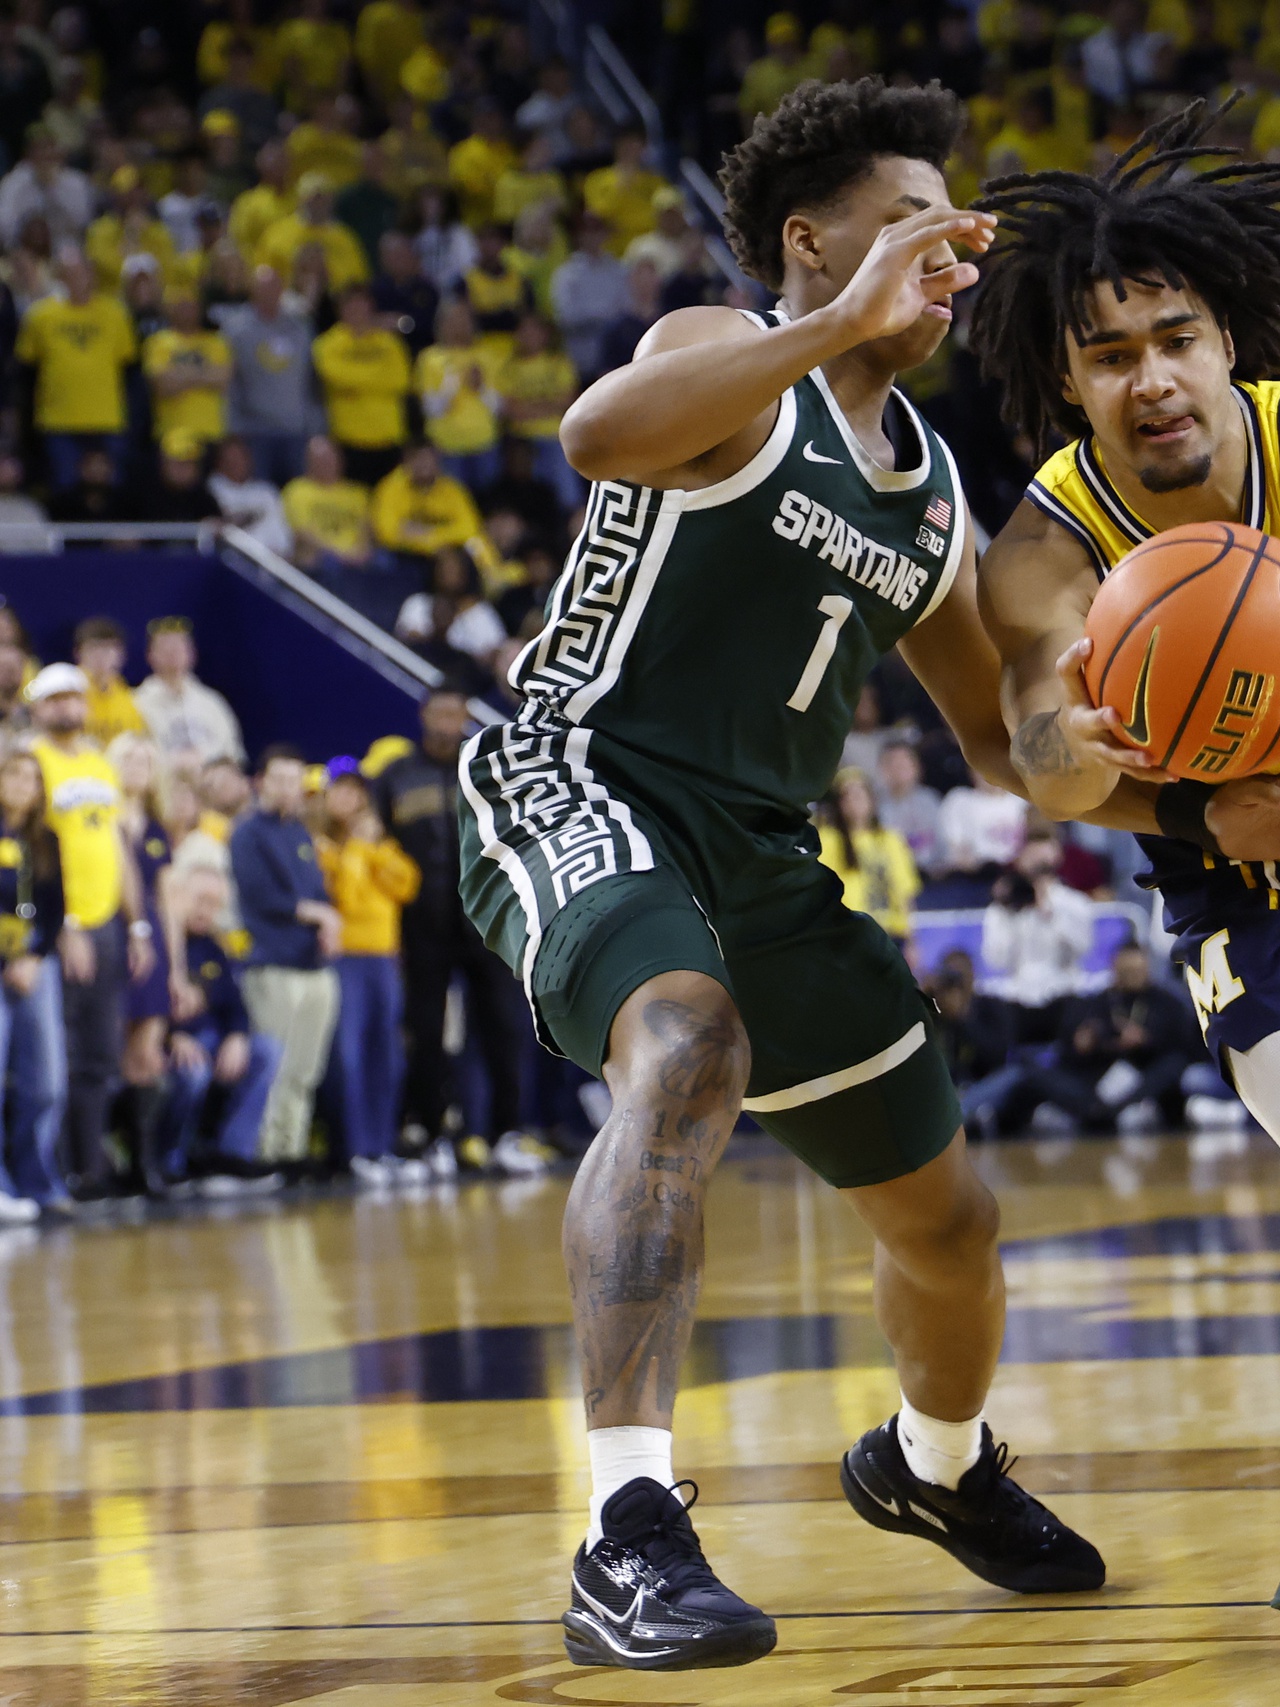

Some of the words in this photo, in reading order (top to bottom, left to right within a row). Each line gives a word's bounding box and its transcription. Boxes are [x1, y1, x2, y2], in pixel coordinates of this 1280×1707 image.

[771, 489, 929, 612] SPARTANS
[785, 594, 854, 713] 1
[1187, 667, 1266, 774] ELITE
[1186, 927, 1246, 1048] M
